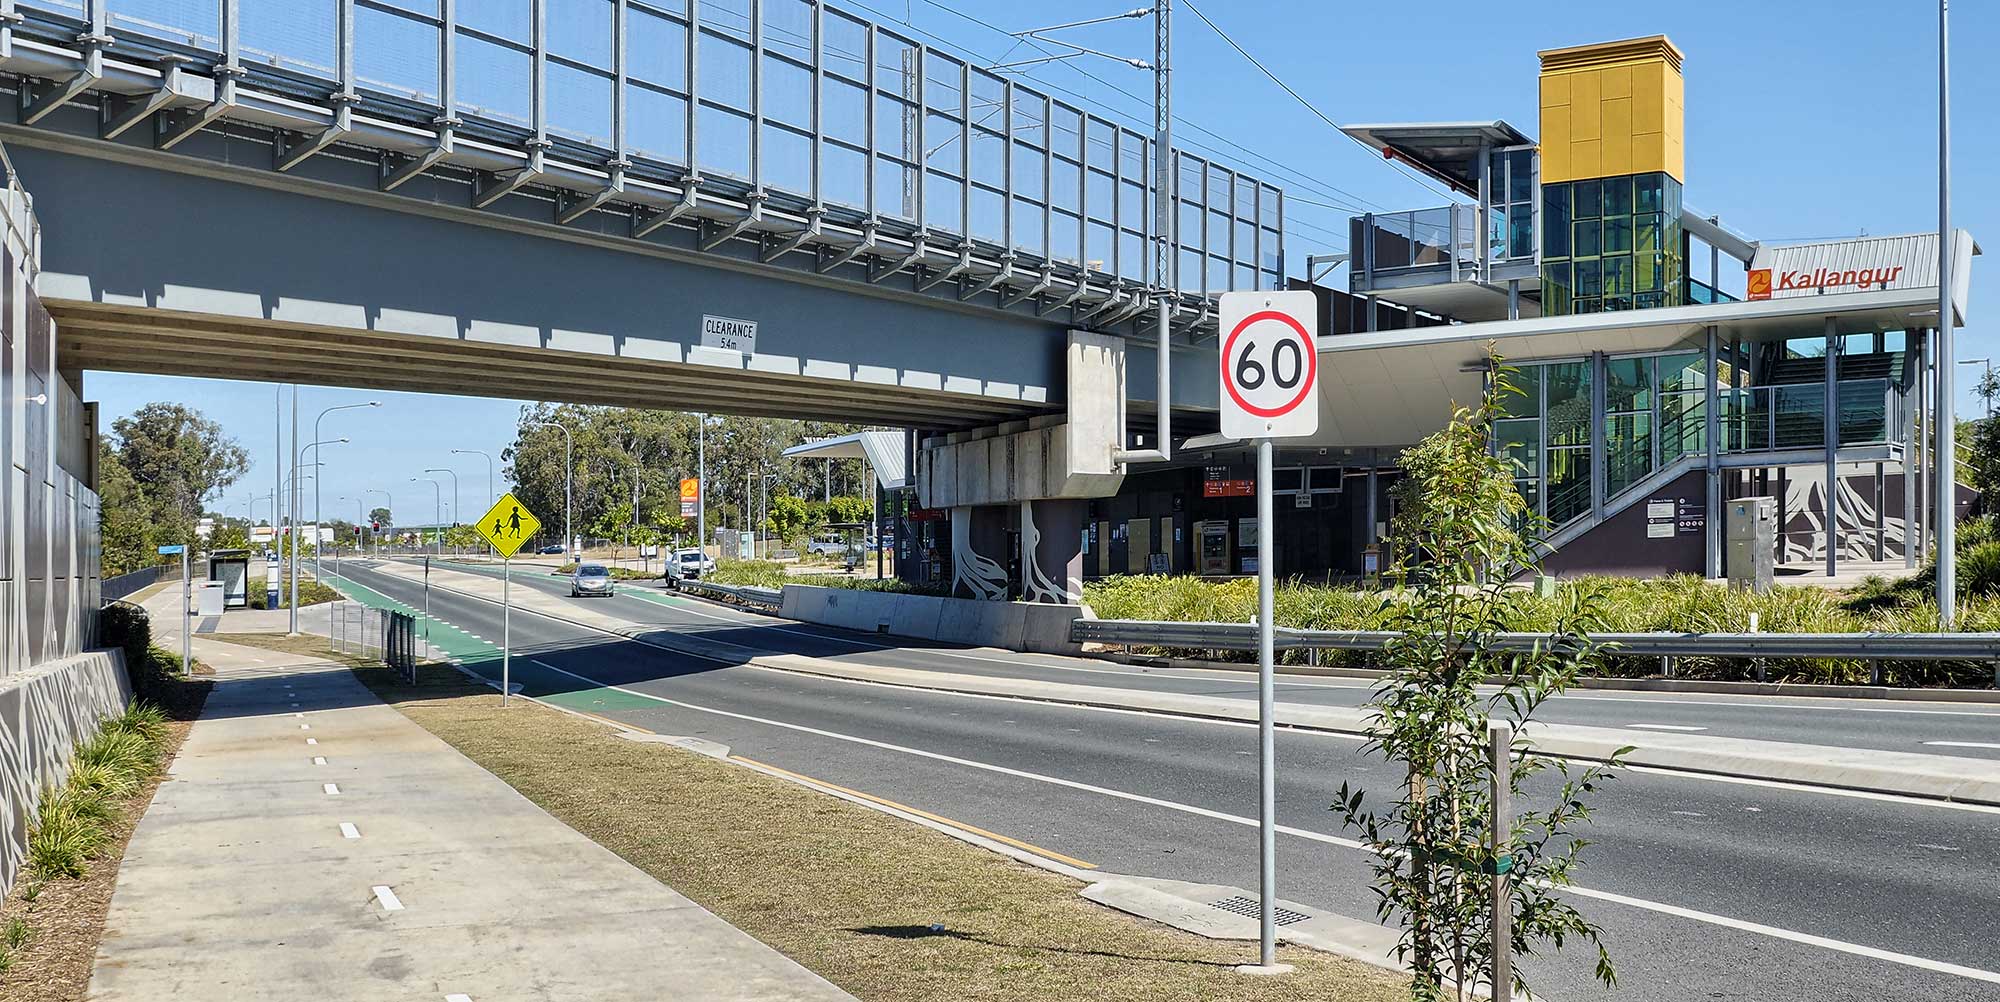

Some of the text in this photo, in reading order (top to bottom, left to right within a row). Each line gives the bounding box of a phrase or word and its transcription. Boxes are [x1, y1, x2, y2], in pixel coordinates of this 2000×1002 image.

[1778, 266, 1903, 289] Kallangur
[706, 319, 753, 339] CLEARANCE
[1236, 338, 1302, 390] 60
